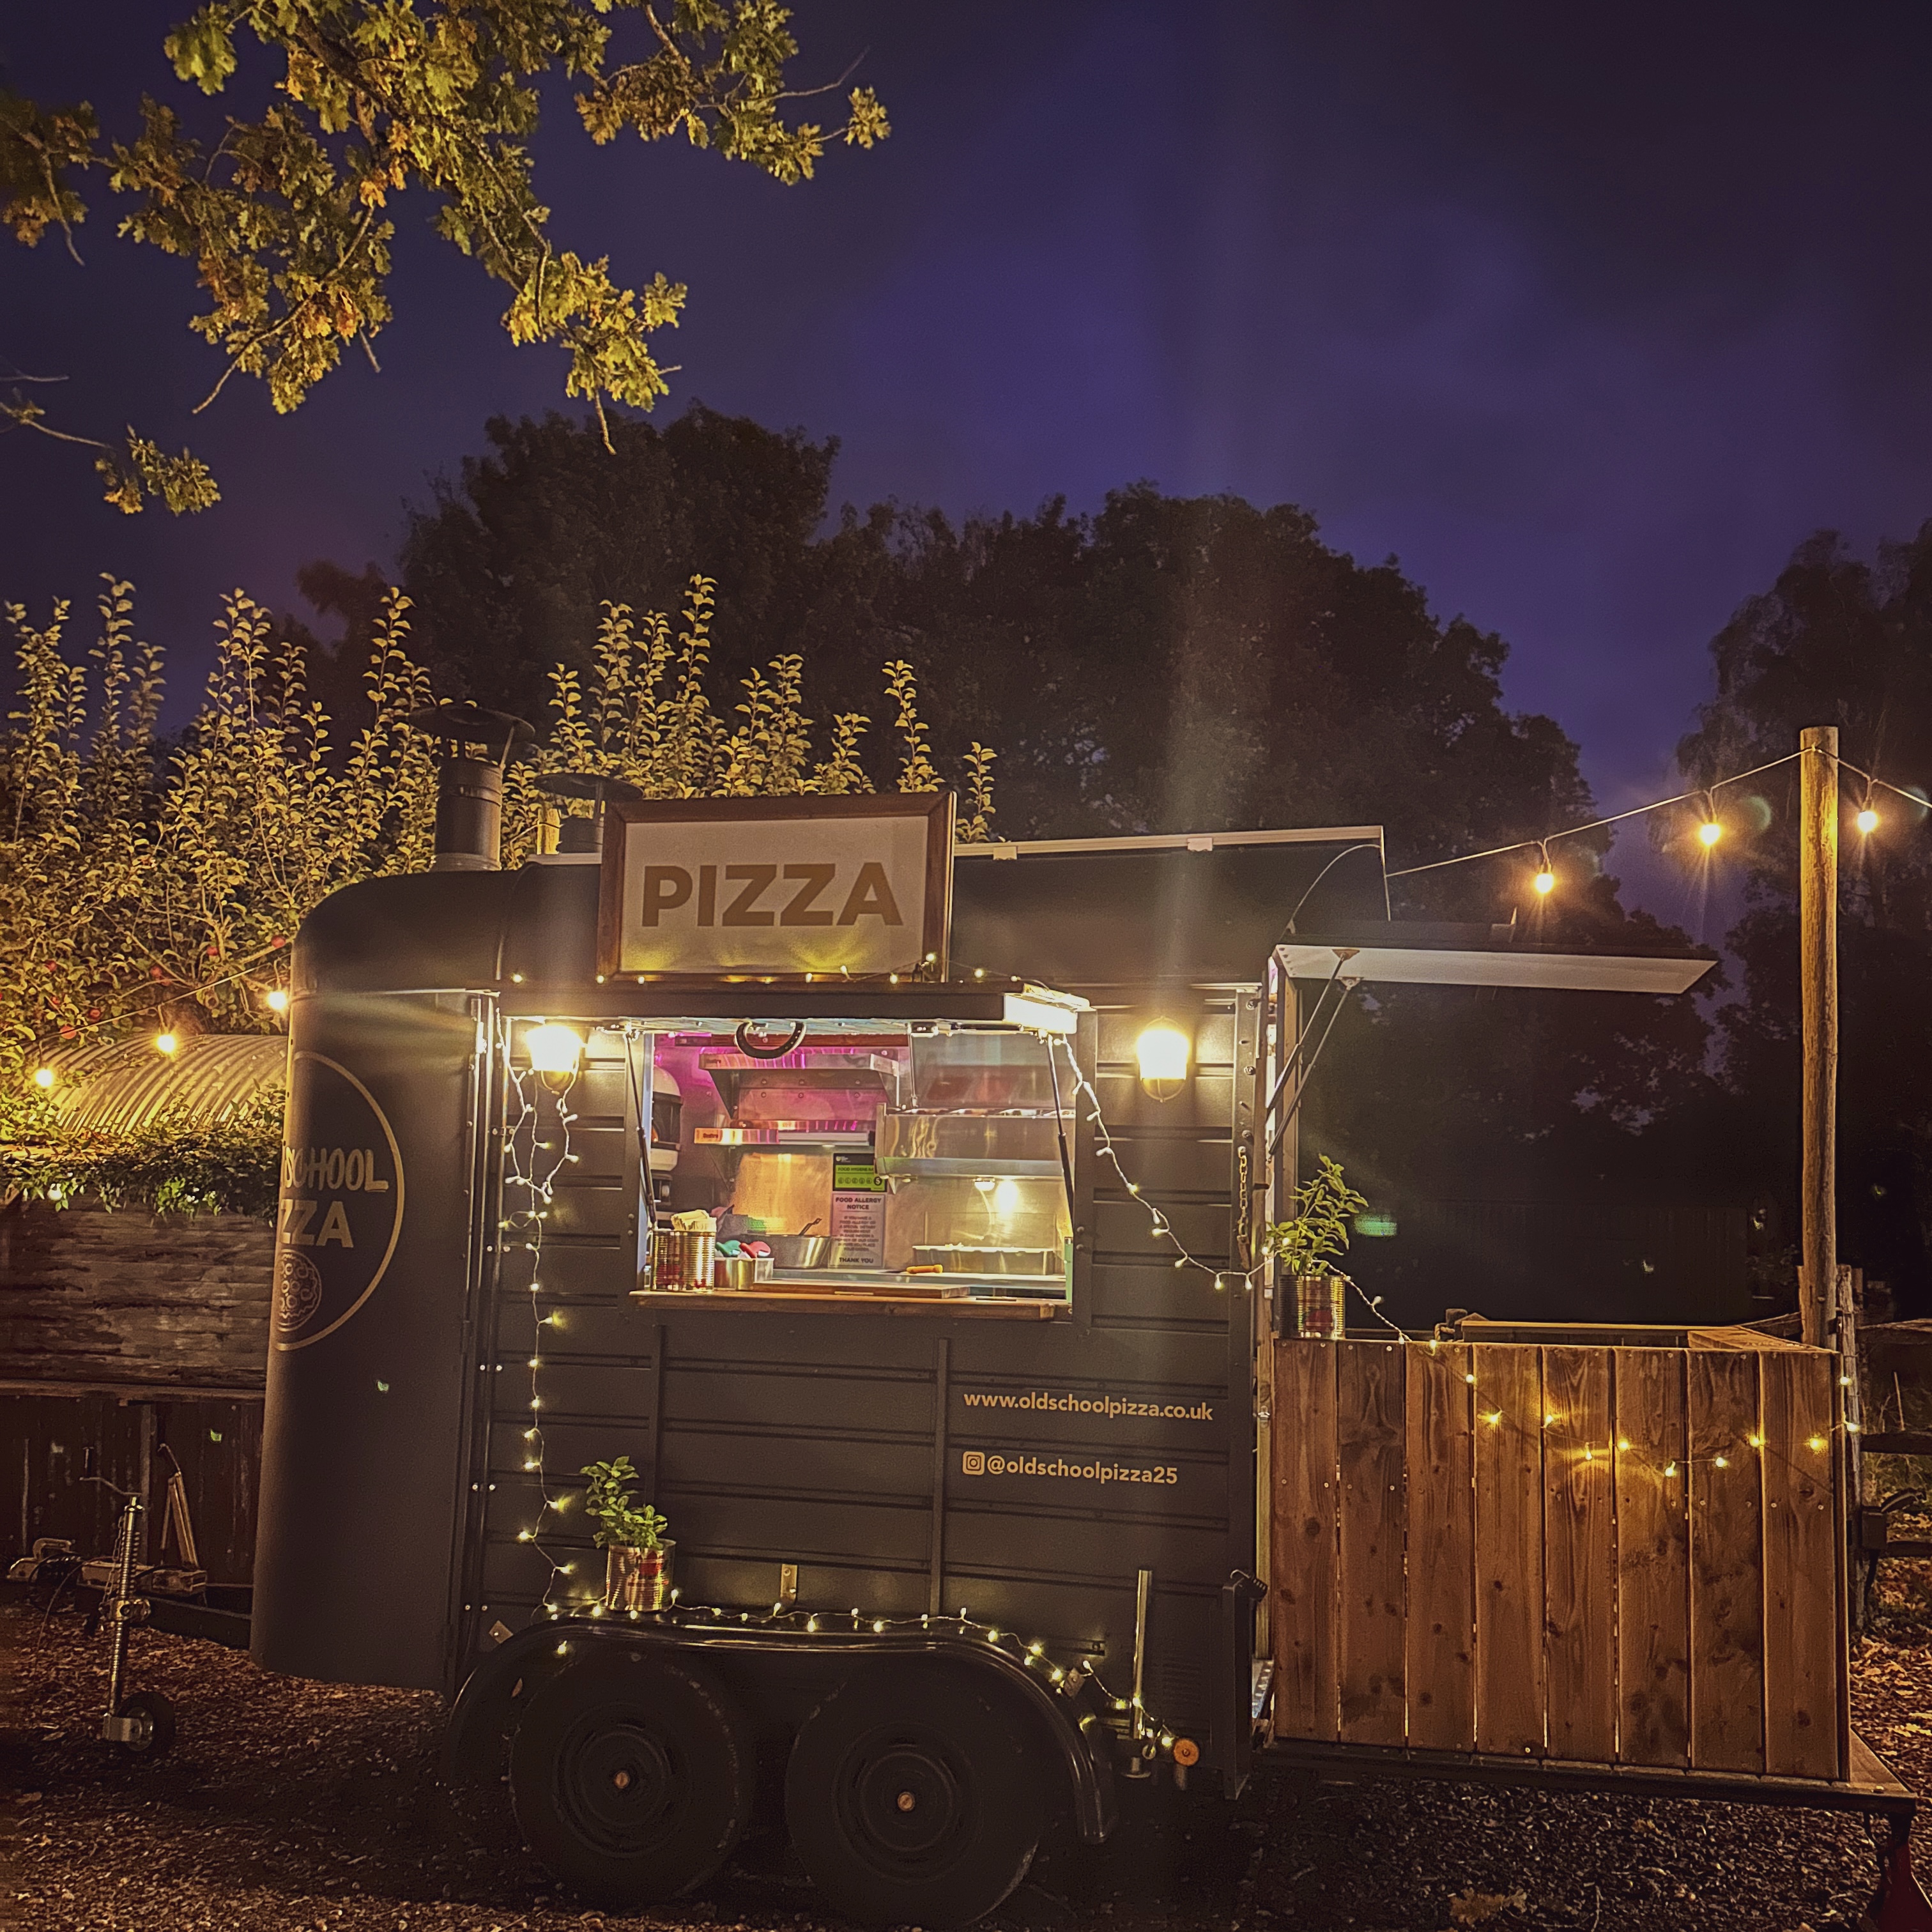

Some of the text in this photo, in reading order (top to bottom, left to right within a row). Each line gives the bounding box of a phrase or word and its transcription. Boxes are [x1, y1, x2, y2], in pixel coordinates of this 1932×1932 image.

[641, 862, 903, 927] PIZZA
[285, 1147, 388, 1192] SCHOOL
[963, 1392, 1213, 1421] www.oldschoolpizza.co.uk
[987, 1455, 1177, 1485] @oldschoolpizza25
